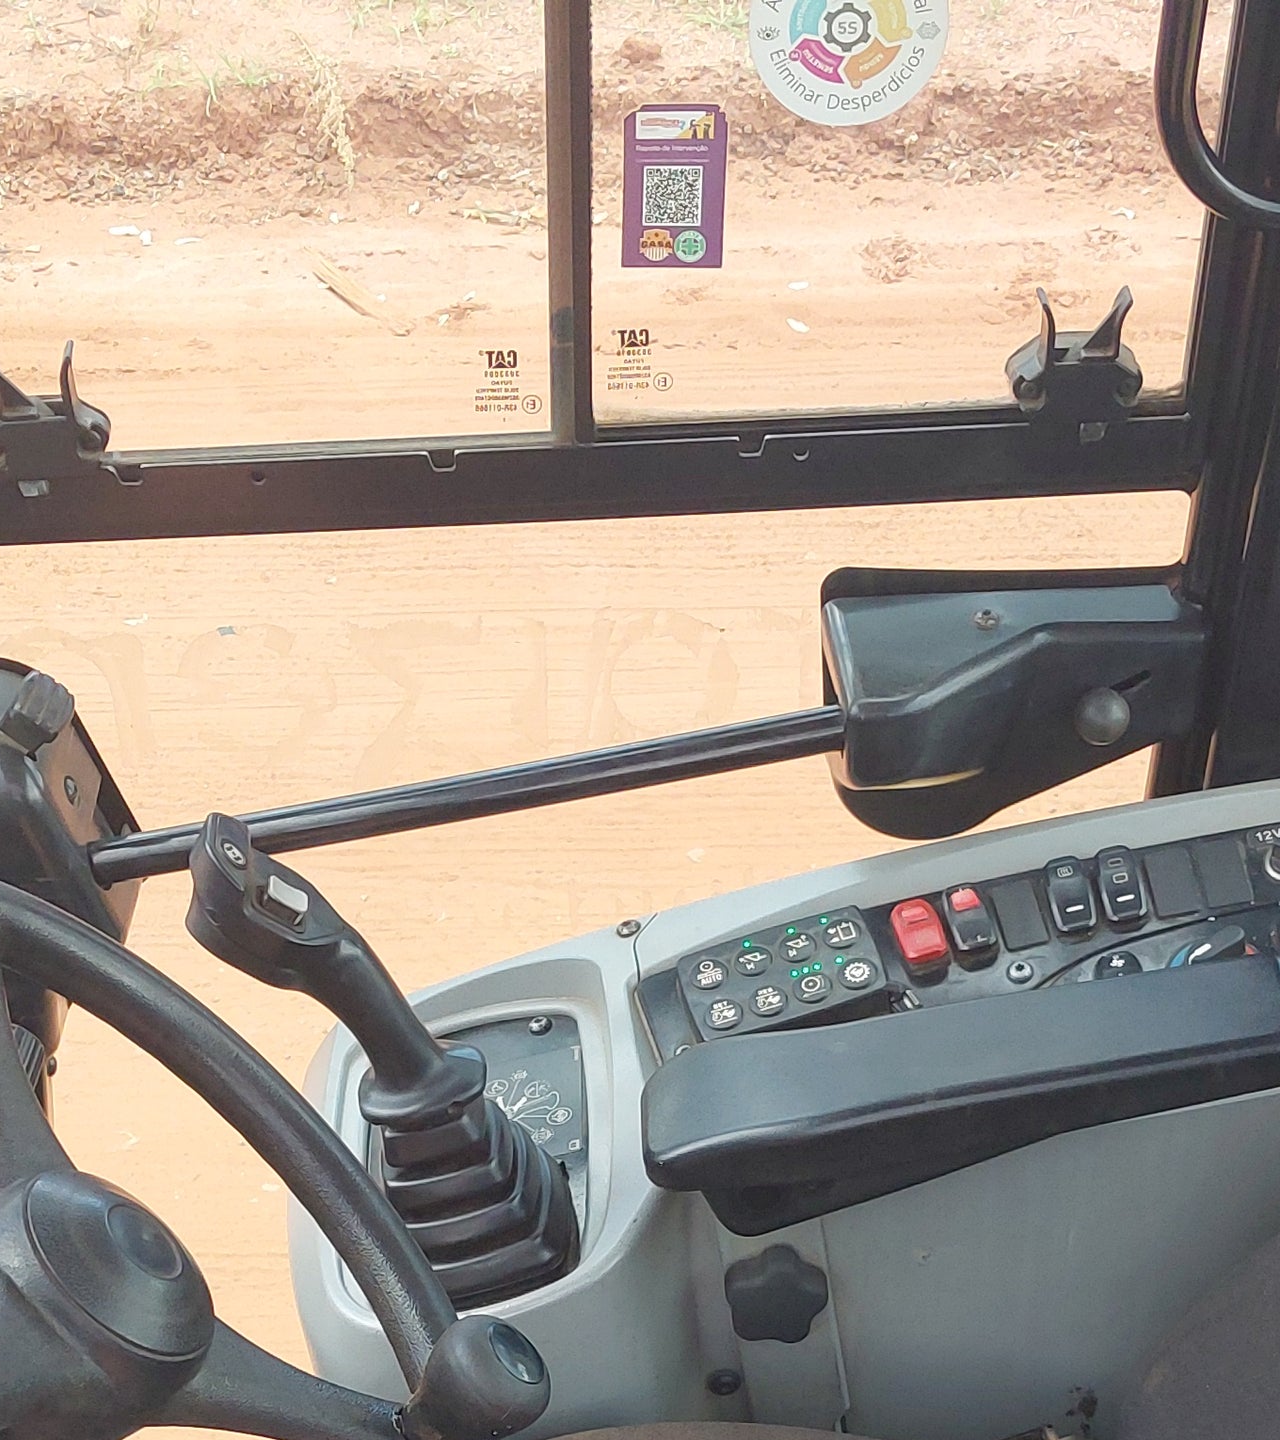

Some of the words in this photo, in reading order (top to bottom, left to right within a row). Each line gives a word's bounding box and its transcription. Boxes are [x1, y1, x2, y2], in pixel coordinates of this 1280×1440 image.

[837, 21, 858, 35] 5S
[769, 48, 825, 105] Eliminar
[826, 46, 926, 112] Desperdícios
[700, 974, 723, 987] AUTO
